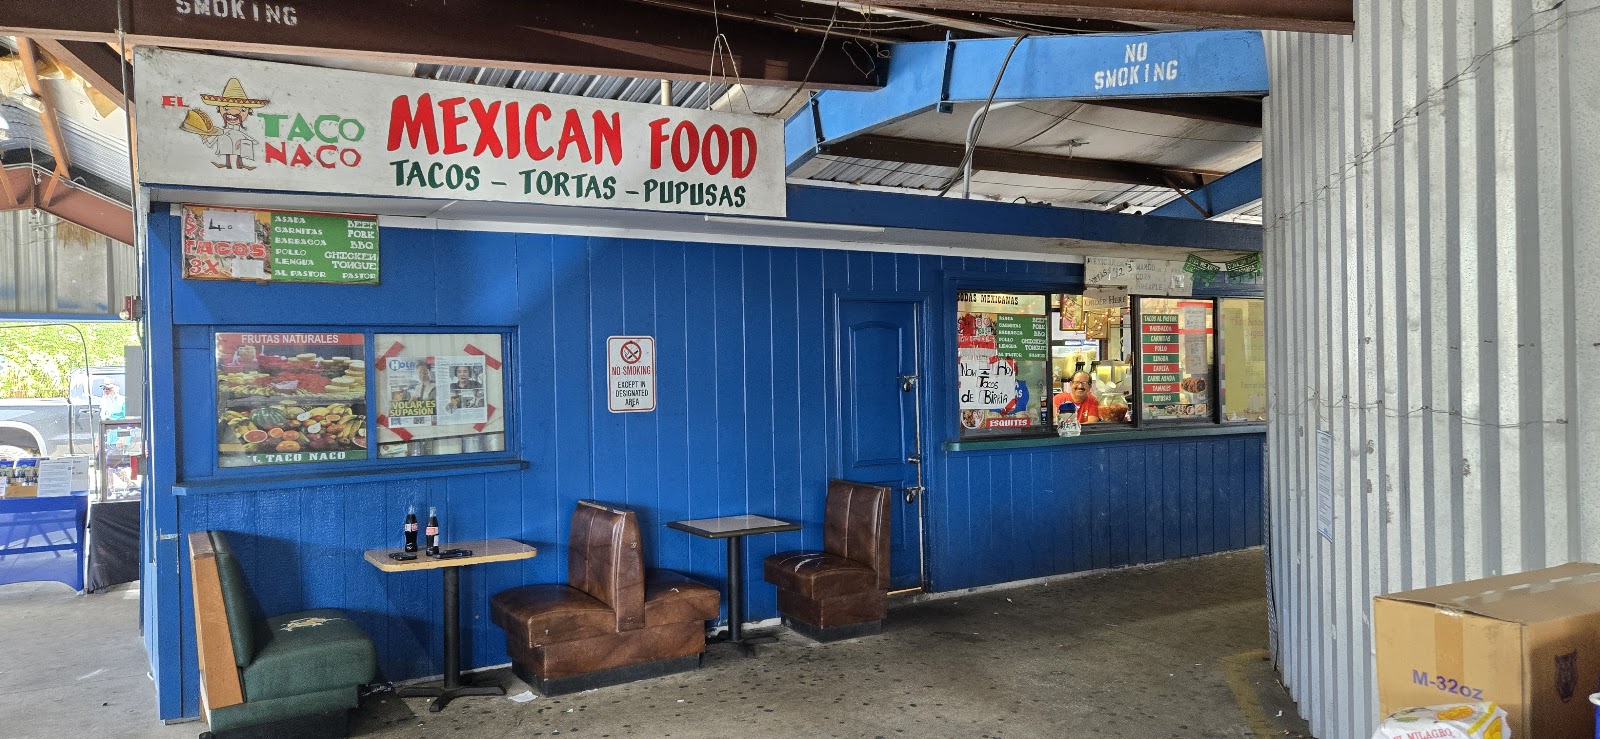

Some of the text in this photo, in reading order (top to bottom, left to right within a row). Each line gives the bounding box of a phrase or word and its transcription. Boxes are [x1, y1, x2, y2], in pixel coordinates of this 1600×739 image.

[175, 0, 298, 26] SMOKING
[1124, 41, 1148, 64] NO
[1094, 59, 1178, 90] SMOKING
[161, 95, 190, 108] EL
[257, 112, 366, 143] TACO
[386, 92, 758, 179] MEXICAN FOOD
[264, 141, 363, 169] NACO
[389, 159, 480, 191] TACOS
[518, 168, 617, 200] TORTAS
[643, 178, 747, 208] PUPUSAS
[347, 219, 377, 230] BEEF
[274, 226, 323, 236] CARNITAS
[347, 230, 375, 239] PORK
[274, 237, 328, 246] BARBACOA
[350, 241, 374, 250] BBQ
[184, 239, 267, 259] TACOS
[324, 251, 377, 261] CHICKEN
[274, 258, 315, 266] LENGUA
[331, 261, 377, 270] TONGUE
[290, 270, 327, 278] PASTOR
[342, 272, 377, 280] PASTOR
[980, 294, 1019, 306] MEXICANAS
[241, 334, 339, 344] FRUTAS NATURALES
[611, 365, 651, 376] NO SMOKING
[617, 380, 646, 388] EXCEPT IN
[615, 389, 649, 397] DESIGNATED
[426, 400, 436, 408] ES
[624, 397, 640, 406] AREA
[389, 409, 400, 417] SU
[990, 419, 1028, 427] ESQUITES
[265, 453, 302, 462] TACO
[309, 451, 346, 460] NACO
[1411, 669, 1484, 701] M-32oz
